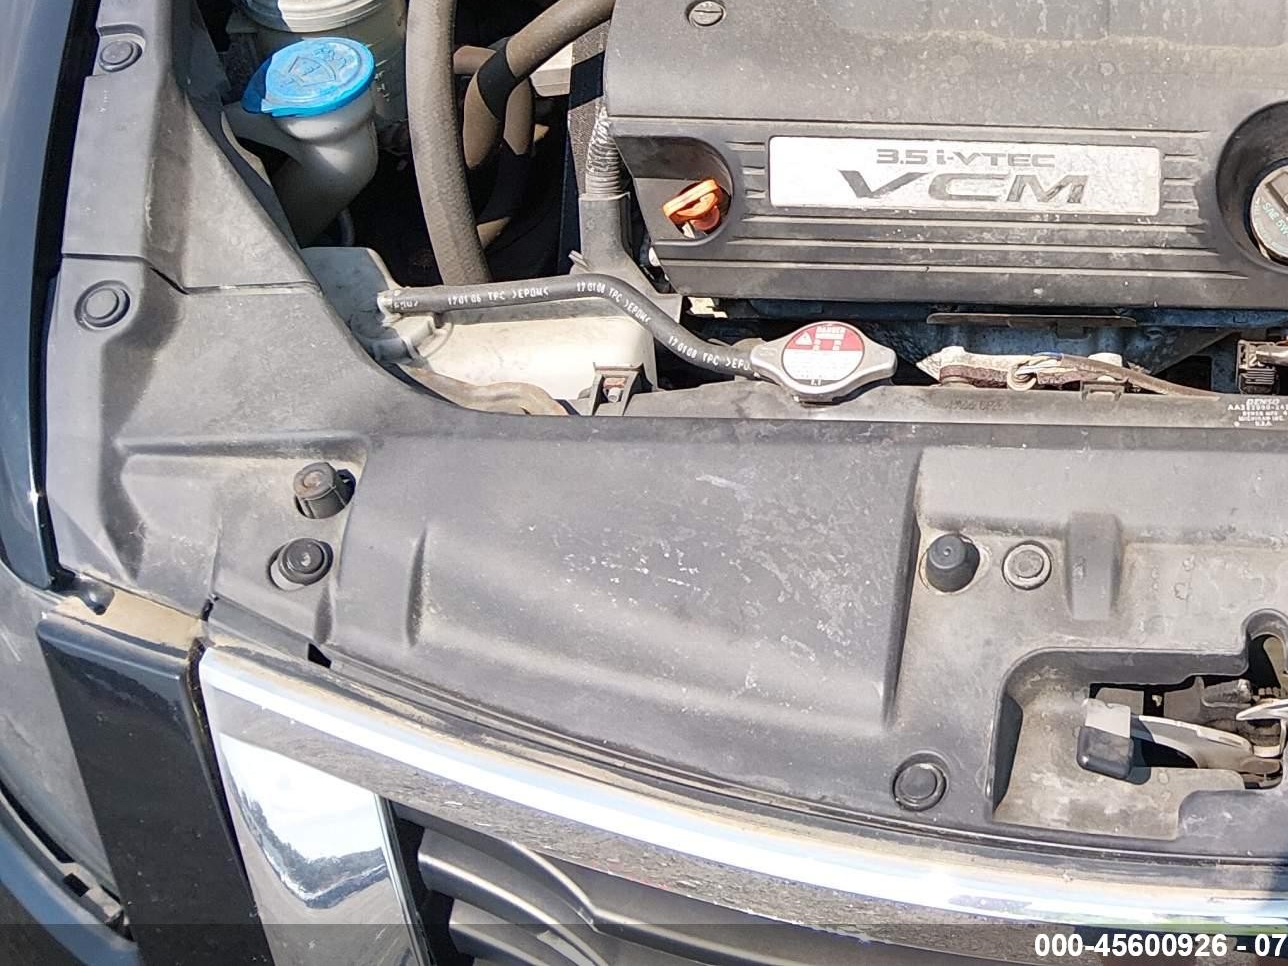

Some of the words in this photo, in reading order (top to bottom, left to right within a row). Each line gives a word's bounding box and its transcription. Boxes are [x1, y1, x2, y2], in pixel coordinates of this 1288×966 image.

[876, 149, 929, 165] 3.5
[936, 150, 1056, 168] i-VTEC
[839, 169, 1089, 204] VCM
[1262, 202, 1280, 221] SAE
[487, 292, 505, 301] TPC
[608, 287, 623, 303] TPC
[702, 352, 720, 366] TPC
